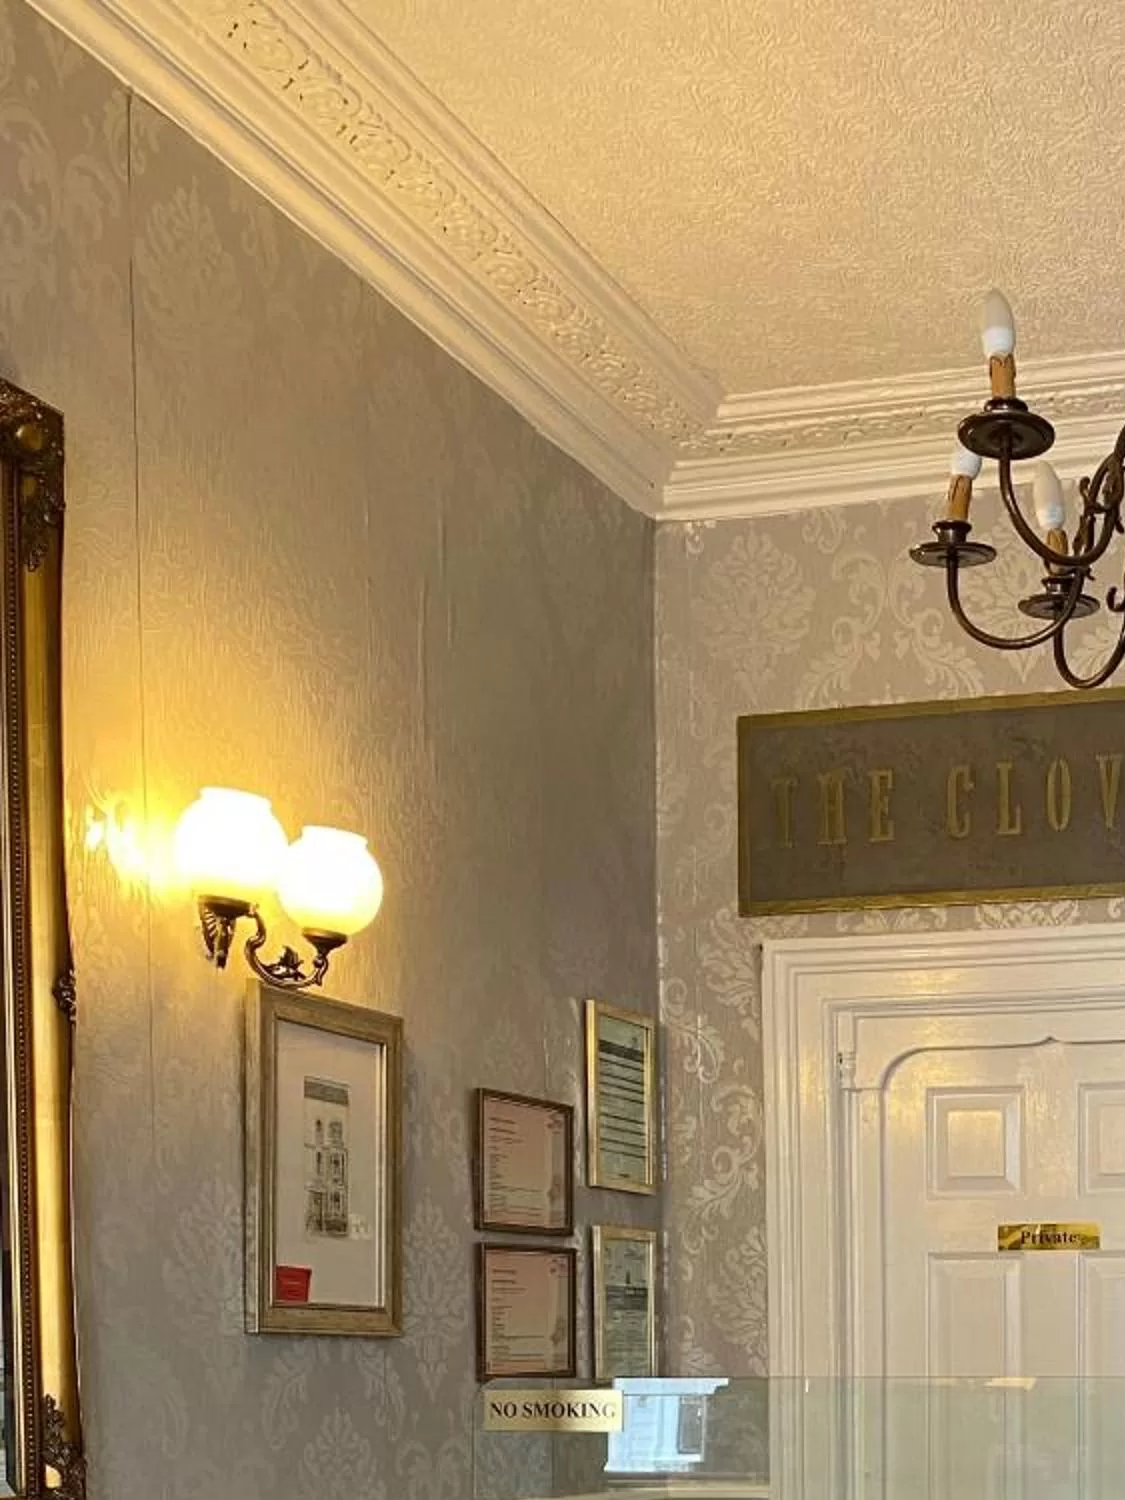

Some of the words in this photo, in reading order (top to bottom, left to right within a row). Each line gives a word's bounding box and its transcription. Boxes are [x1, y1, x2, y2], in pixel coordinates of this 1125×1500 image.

[770, 766, 896, 850] THE
[1021, 1231, 1080, 1245] Private
[490, 1402, 517, 1419] NO
[522, 1401, 615, 1419] SMOKING
